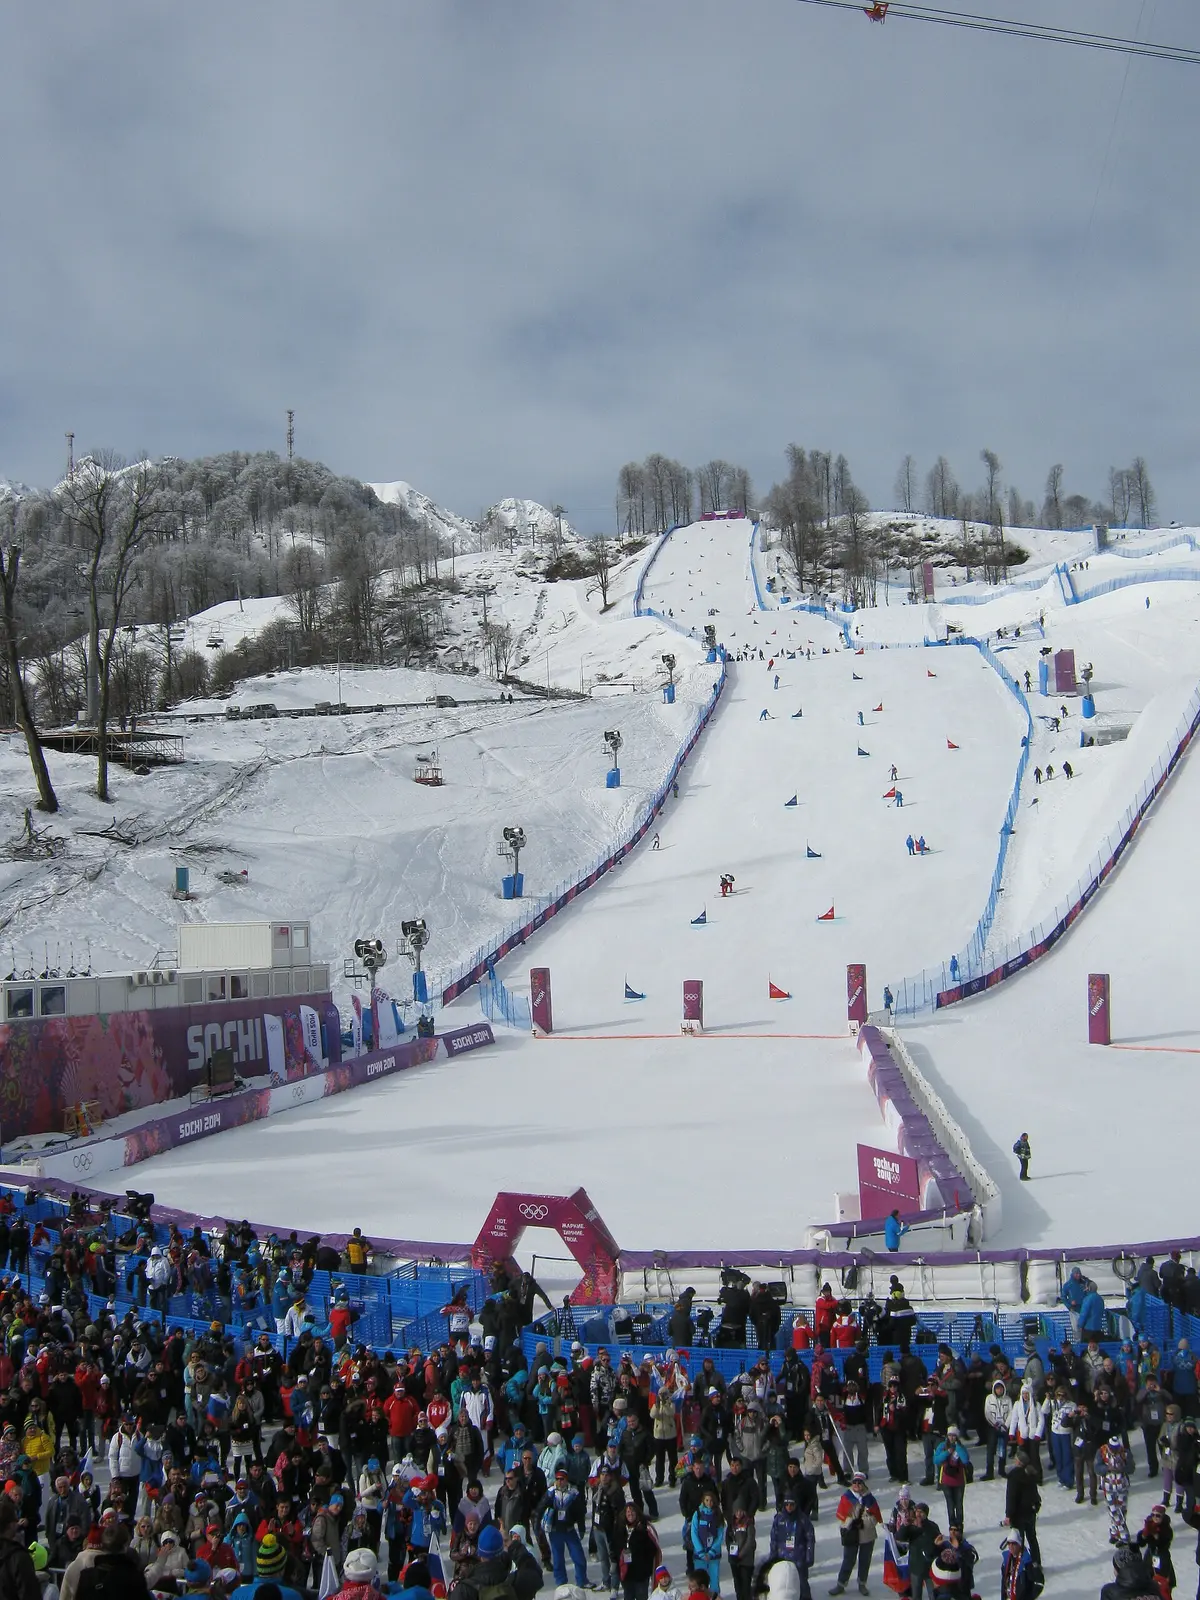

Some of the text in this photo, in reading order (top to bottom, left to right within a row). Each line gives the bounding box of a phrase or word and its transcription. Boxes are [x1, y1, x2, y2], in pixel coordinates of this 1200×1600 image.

[533, 989, 546, 1008] FINISH
[1090, 997, 1105, 1016] FINISH
[187, 1017, 263, 1071] SOCHI
[452, 1029, 490, 1050] SOCHI 2014
[383, 1056, 396, 1070] 2014
[179, 1112, 221, 1139] SOCHI 2014
